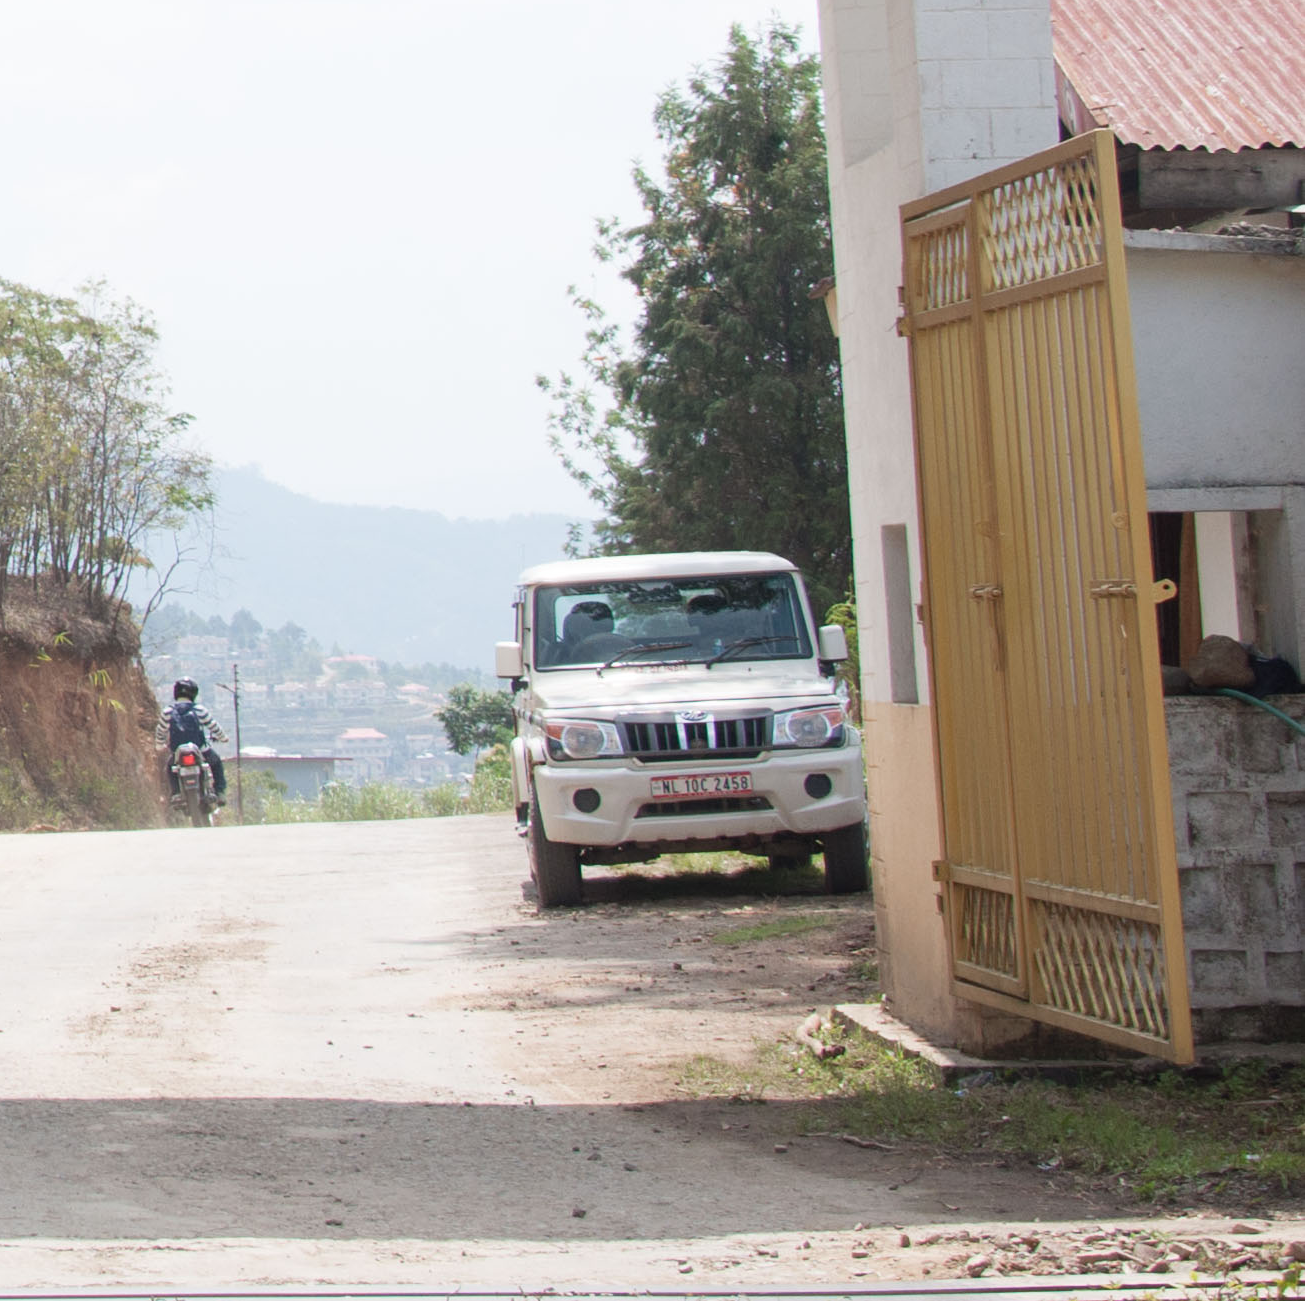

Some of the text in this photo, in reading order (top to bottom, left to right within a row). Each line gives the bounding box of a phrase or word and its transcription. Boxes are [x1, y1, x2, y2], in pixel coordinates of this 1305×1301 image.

[662, 779, 679, 794] NL
[685, 778, 708, 793] 10C
[715, 775, 749, 792] 2458
